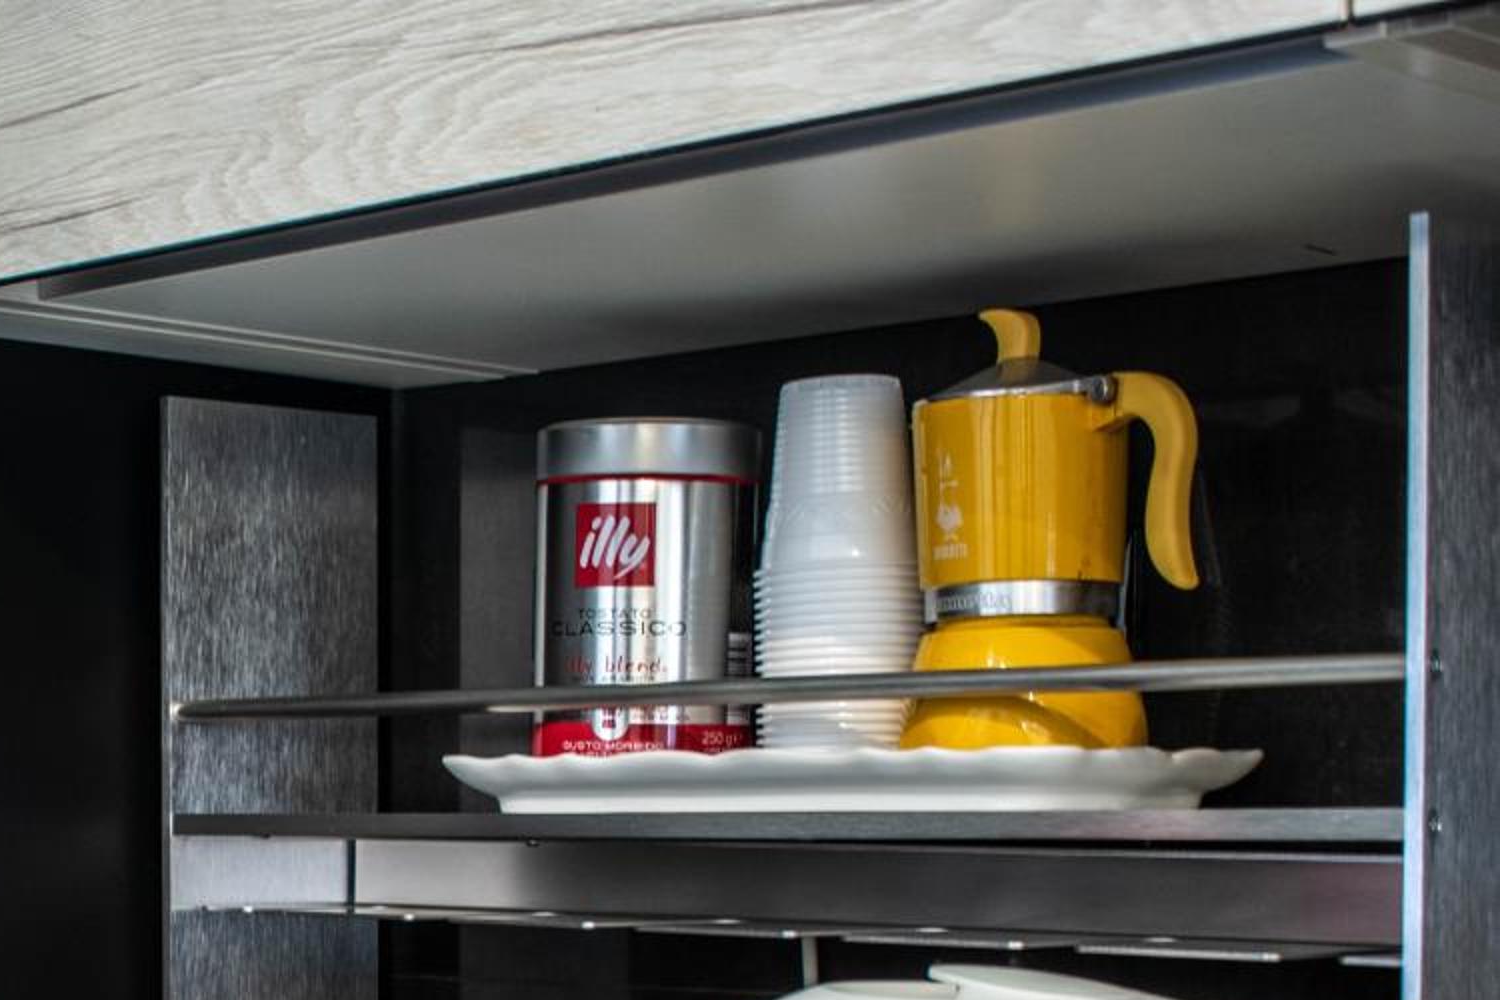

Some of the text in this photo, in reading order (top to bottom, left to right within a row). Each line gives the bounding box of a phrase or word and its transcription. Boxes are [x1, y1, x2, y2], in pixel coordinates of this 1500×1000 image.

[580, 514, 651, 579] illy
[550, 621, 687, 637] CLASSICO
[702, 731, 724, 745] 250
